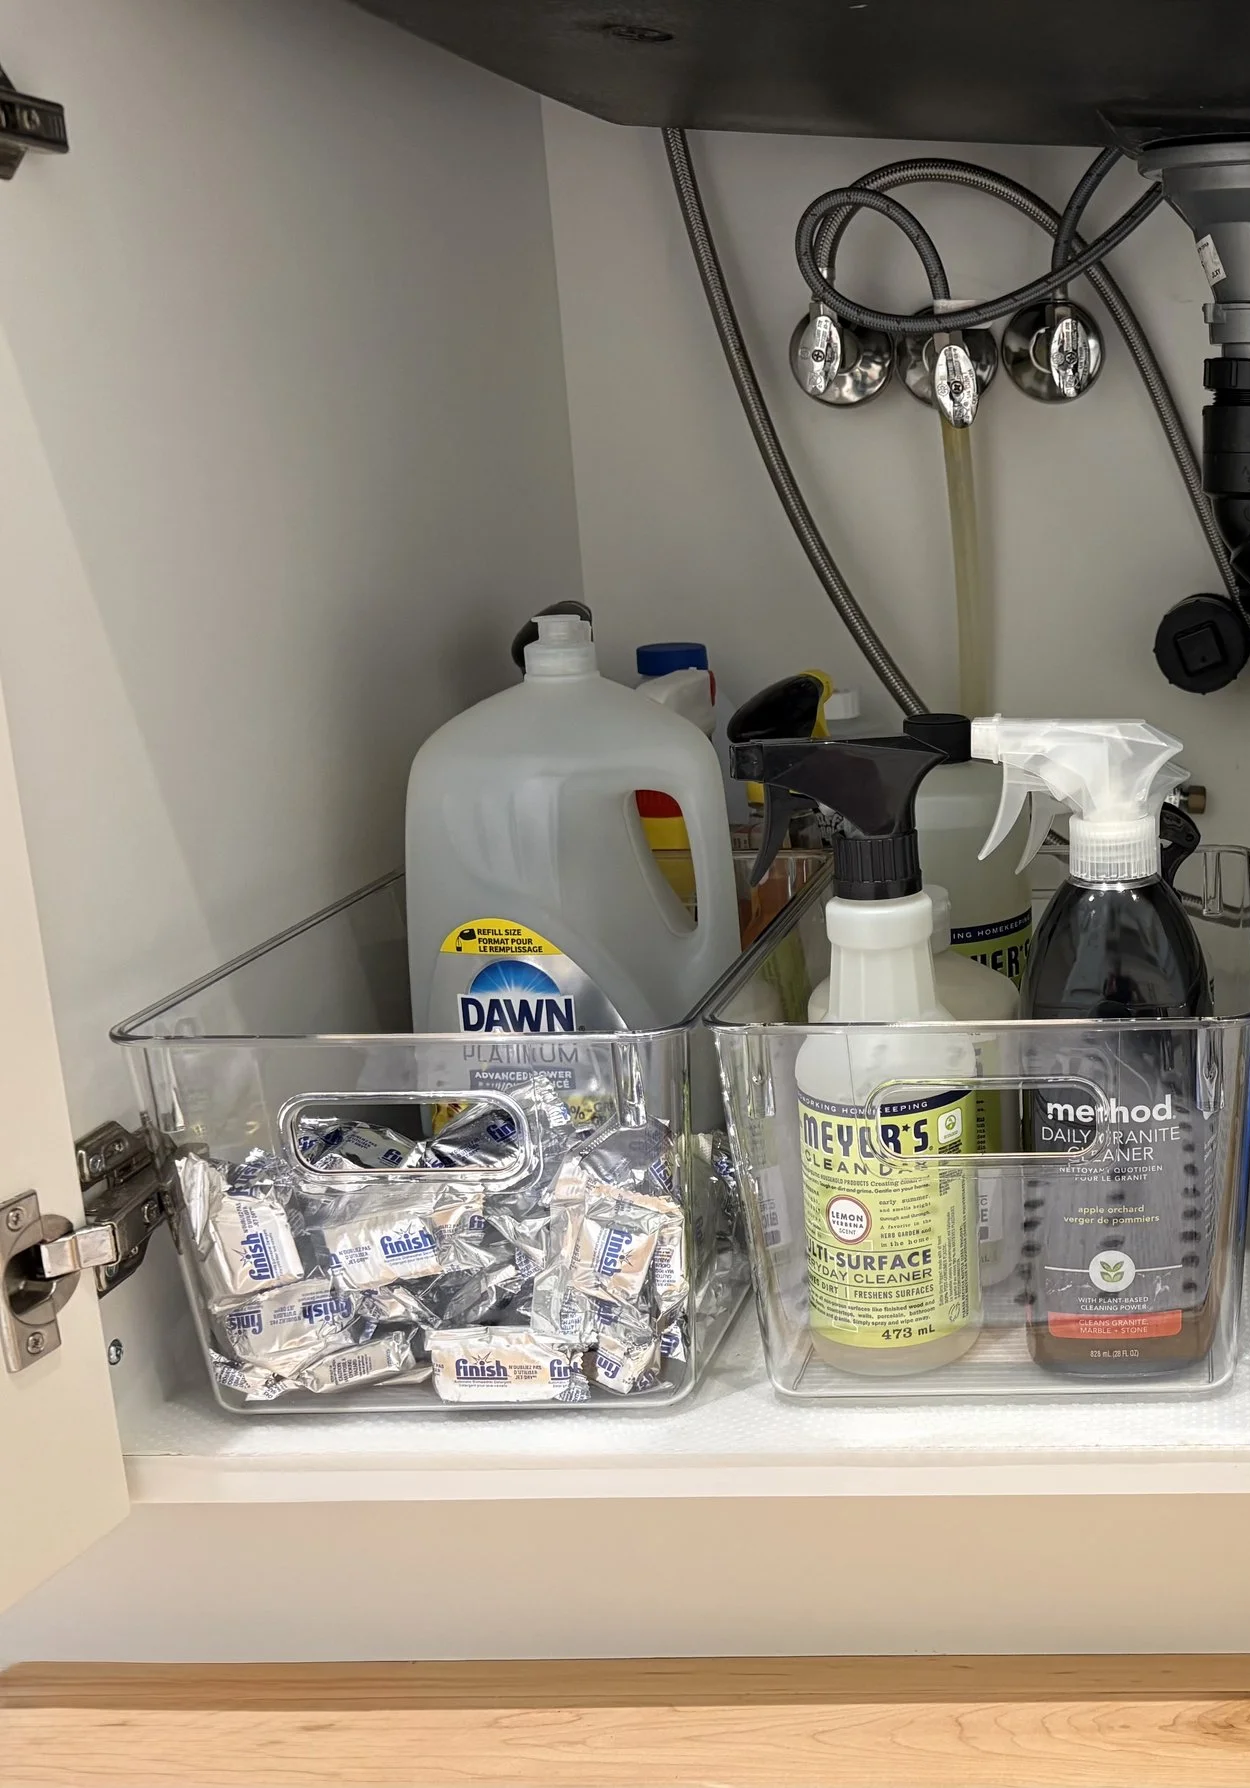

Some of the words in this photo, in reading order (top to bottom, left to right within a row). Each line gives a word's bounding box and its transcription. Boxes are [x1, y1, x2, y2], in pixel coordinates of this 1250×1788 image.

[477, 928, 503, 936] REFILL
[505, 928, 522, 936] SIZE
[478, 938, 509, 946] FORMAT
[511, 938, 533, 946] POUR
[479, 945, 488, 953] LE
[460, 997, 575, 1032] DAWN
[463, 1043, 579, 1063] PLATINUM
[475, 1072, 528, 1081] ADVANCED
[1042, 1127, 1092, 1143] DAILY
[1068, 1146, 1154, 1162] CANER
[805, 1149, 868, 1176] CLEAN
[1114, 1165, 1162, 1173] QUOTIDIEN
[902, 1194, 930, 1203] summer.
[831, 1211, 863, 1221] LEMON
[1078, 1205, 1105, 1216] apple
[1107, 1204, 1145, 1214] orchard
[832, 1220, 864, 1229] VERBENA
[1064, 1216, 1095, 1226] verger
[1097, 1216, 1109, 1224] de
[1112, 1214, 1160, 1226] pommiers
[380, 1230, 436, 1255] finish
[908, 1236, 930, 1244] home
[240, 1232, 271, 1281] finish
[601, 1228, 633, 1277] finish
[854, 1268, 932, 1284] CLEANER
[822, 1282, 838, 1294] DIRT
[854, 1290, 893, 1299] FRESHENS
[896, 1284, 934, 1298] SURFACES
[925, 1299, 935, 1307] and
[301, 1299, 352, 1325] finish
[909, 1307, 935, 1316] bathroom
[881, 1328, 912, 1340] 473
[918, 1324, 935, 1336] mL
[455, 1358, 509, 1377] finish
